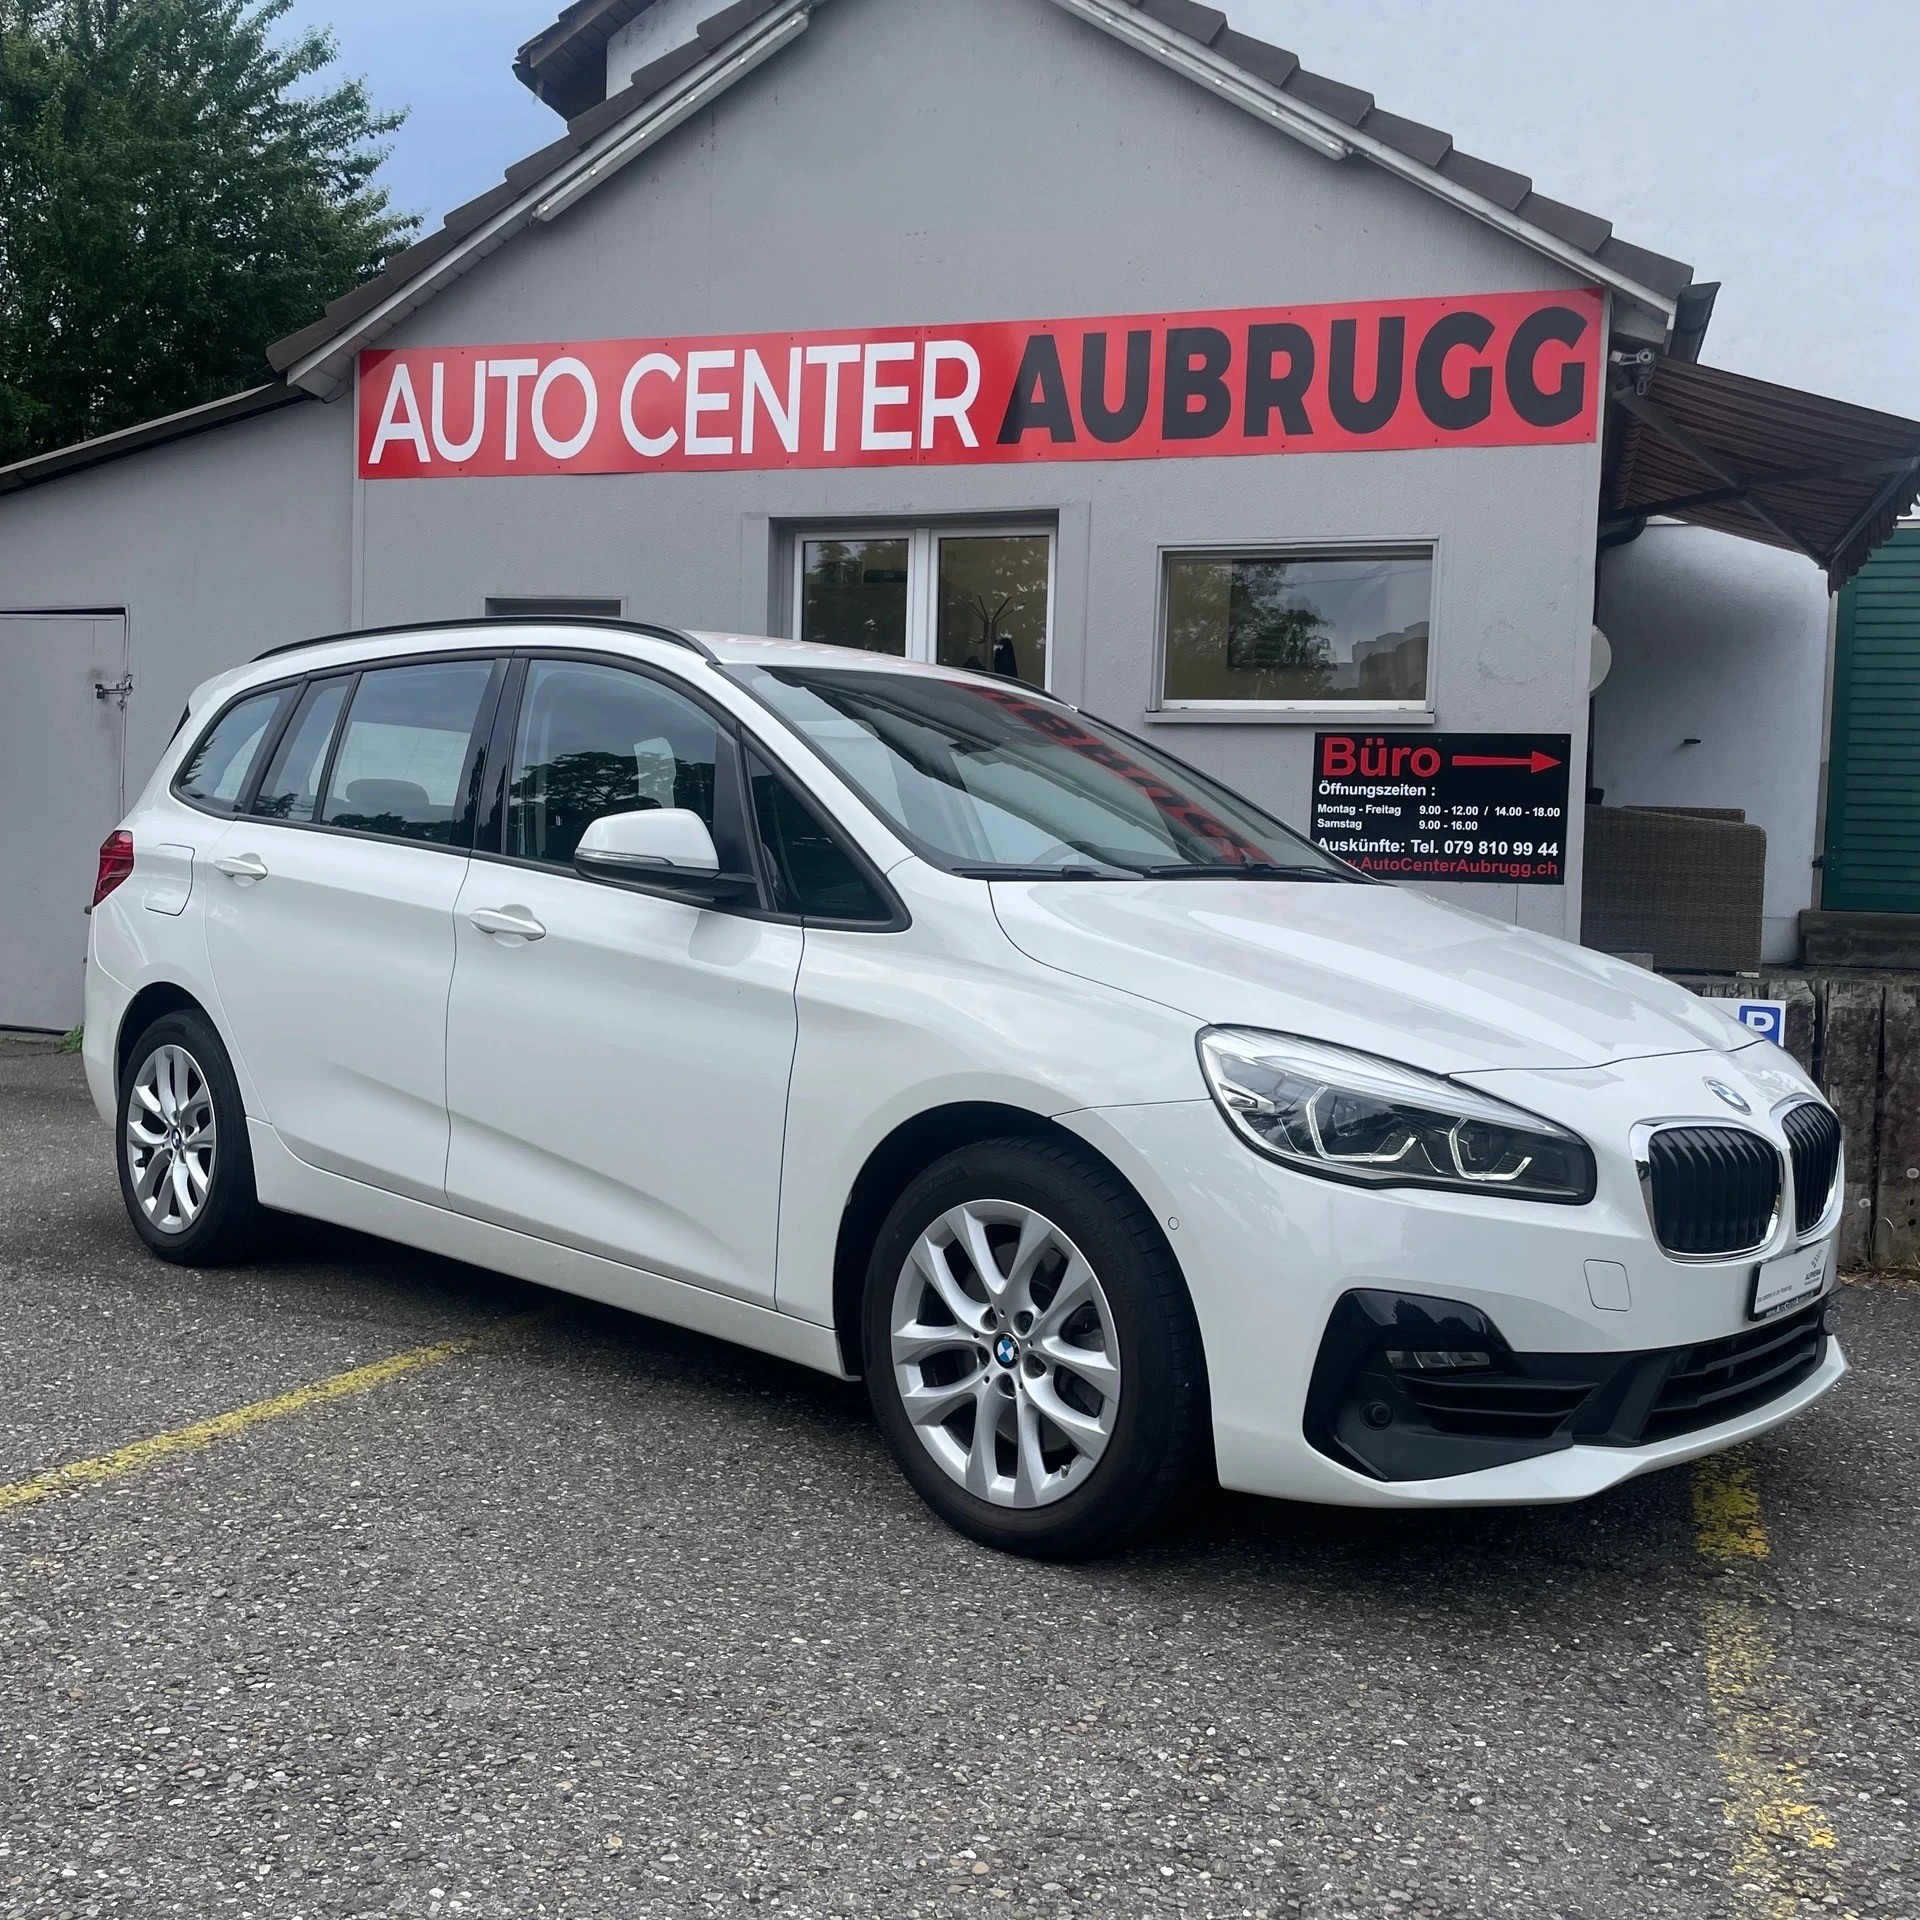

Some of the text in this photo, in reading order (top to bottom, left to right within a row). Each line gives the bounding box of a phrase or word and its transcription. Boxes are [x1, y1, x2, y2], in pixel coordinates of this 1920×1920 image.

[368, 306, 1588, 465] AUTO CENTER AUBRUGG
[1323, 737, 1441, 777] Büro
[1318, 780, 1427, 798] Öffnungszeiten
[1317, 803, 1356, 816] Montag
[1365, 804, 1402, 817] Freitag
[1419, 805, 1441, 815] 9.00
[1451, 806, 1479, 816] 12.00
[1494, 806, 1522, 817] 14.00
[1532, 807, 1560, 817] 18.00
[1317, 819, 1362, 831] Samstag
[1418, 820, 1441, 830] 9.00
[1450, 821, 1479, 831] 16.00
[1318, 838, 1559, 857] Auskünfte: Tel. 079 810 99 44
[1745, 1010, 1775, 1033] P
